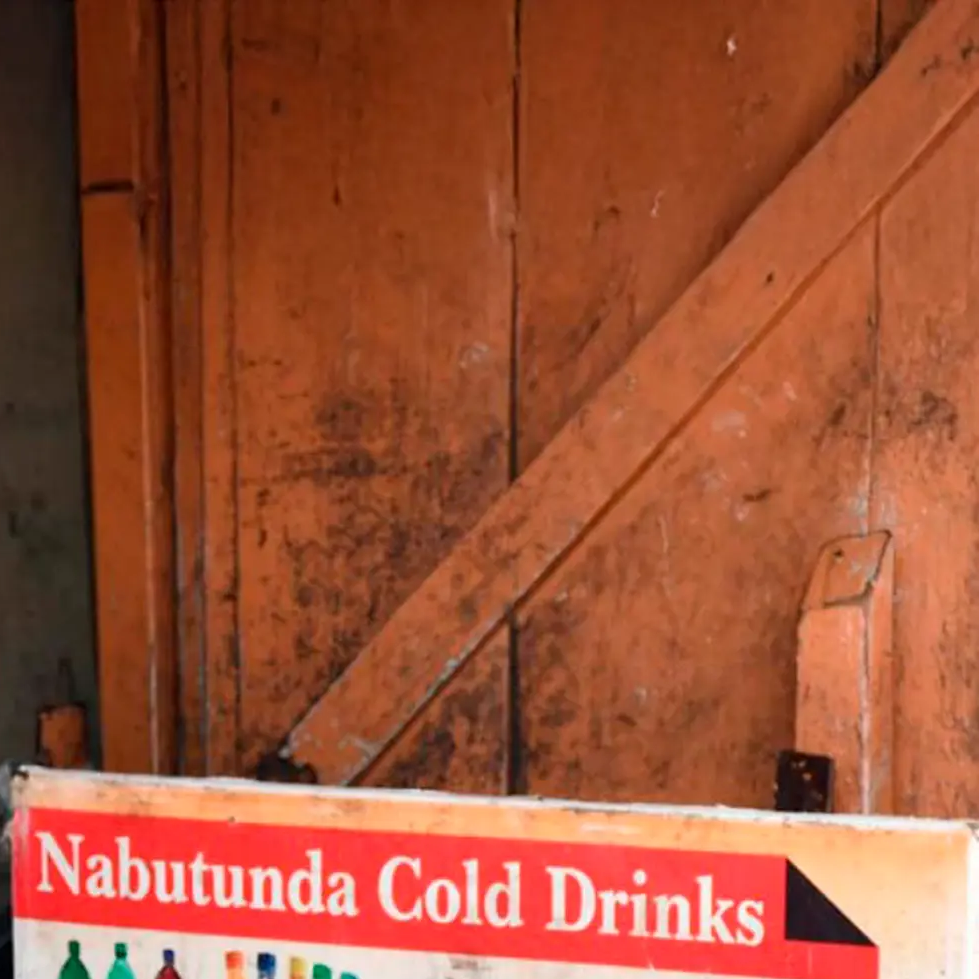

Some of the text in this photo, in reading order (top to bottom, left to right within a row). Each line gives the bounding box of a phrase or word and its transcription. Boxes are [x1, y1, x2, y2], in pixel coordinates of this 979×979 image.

[36, 832, 766, 947] Nabutunda Cold Drinks
